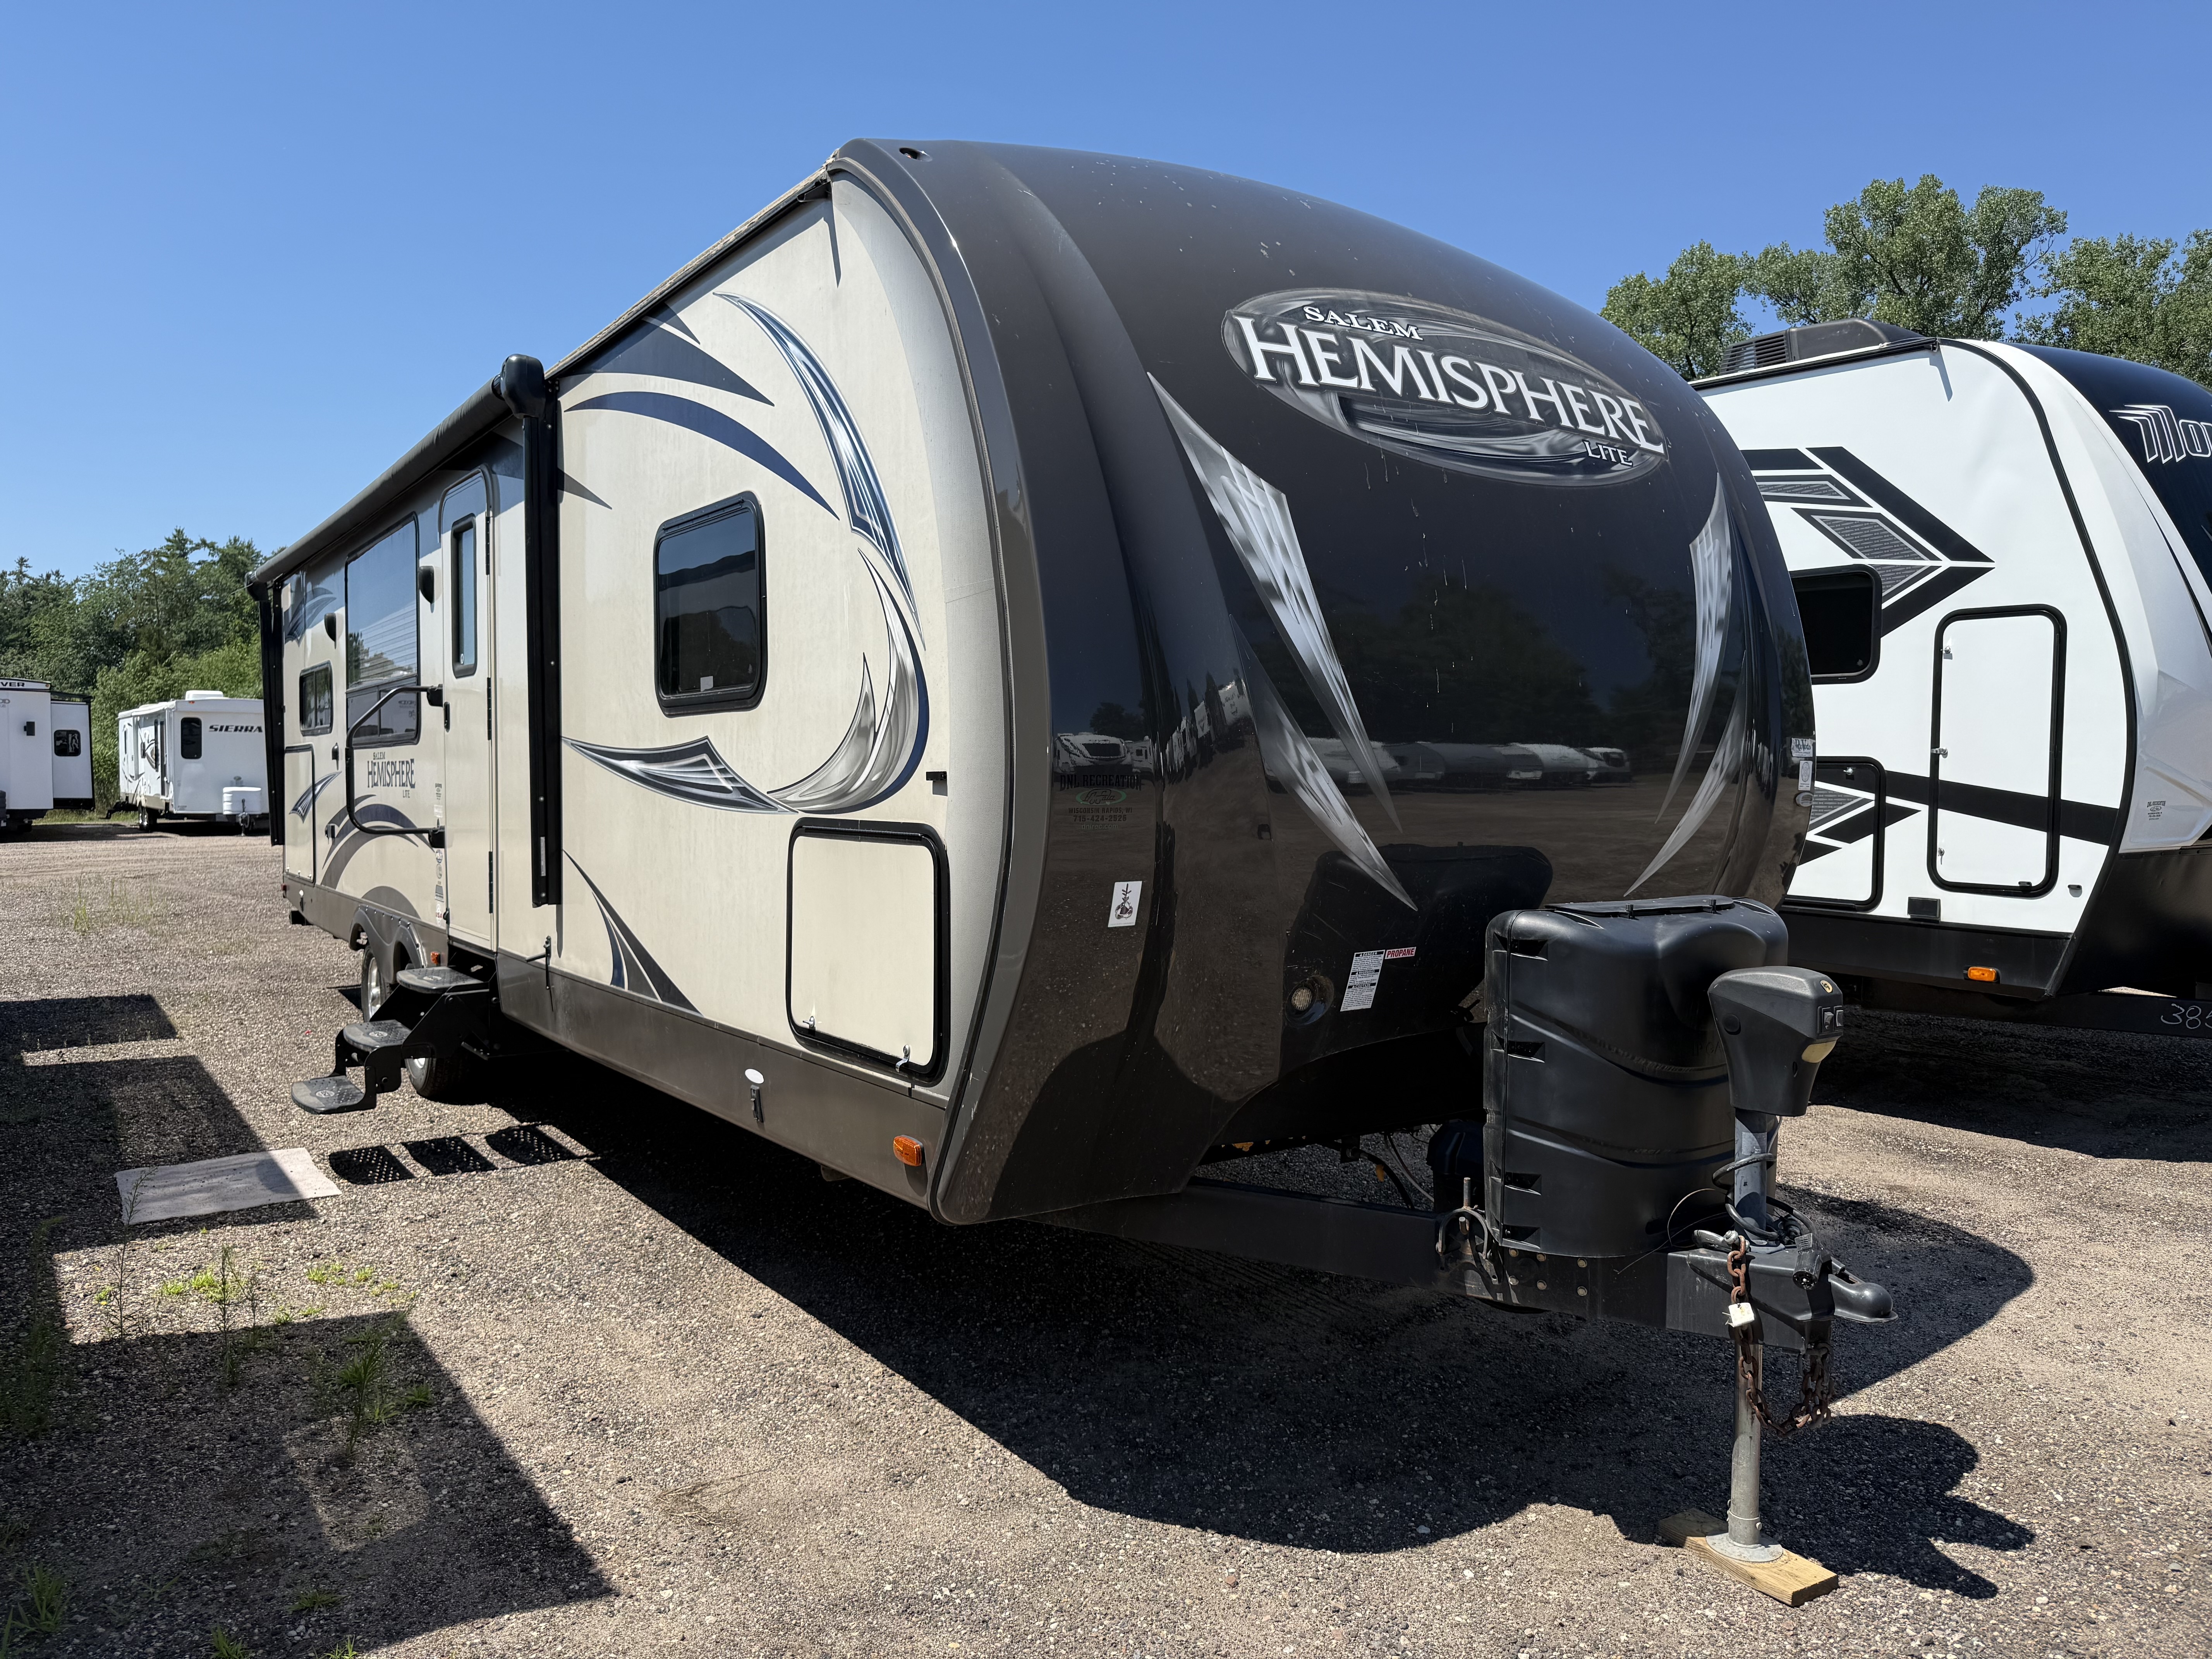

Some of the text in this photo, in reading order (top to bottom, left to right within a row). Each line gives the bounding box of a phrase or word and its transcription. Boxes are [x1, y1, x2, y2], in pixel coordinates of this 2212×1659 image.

[1304, 305, 1423, 341] SALEM
[1232, 315, 1664, 454] HEMISPHERE
[1583, 439, 1633, 467] LITE
[209, 725, 263, 733] SIERRA
[373, 752, 385, 760] SALEM
[367, 758, 416, 788] HEMISPHERE
[1060, 774, 1141, 791] DNL RECREATION
[1387, 948, 1415, 958] PROPANE
